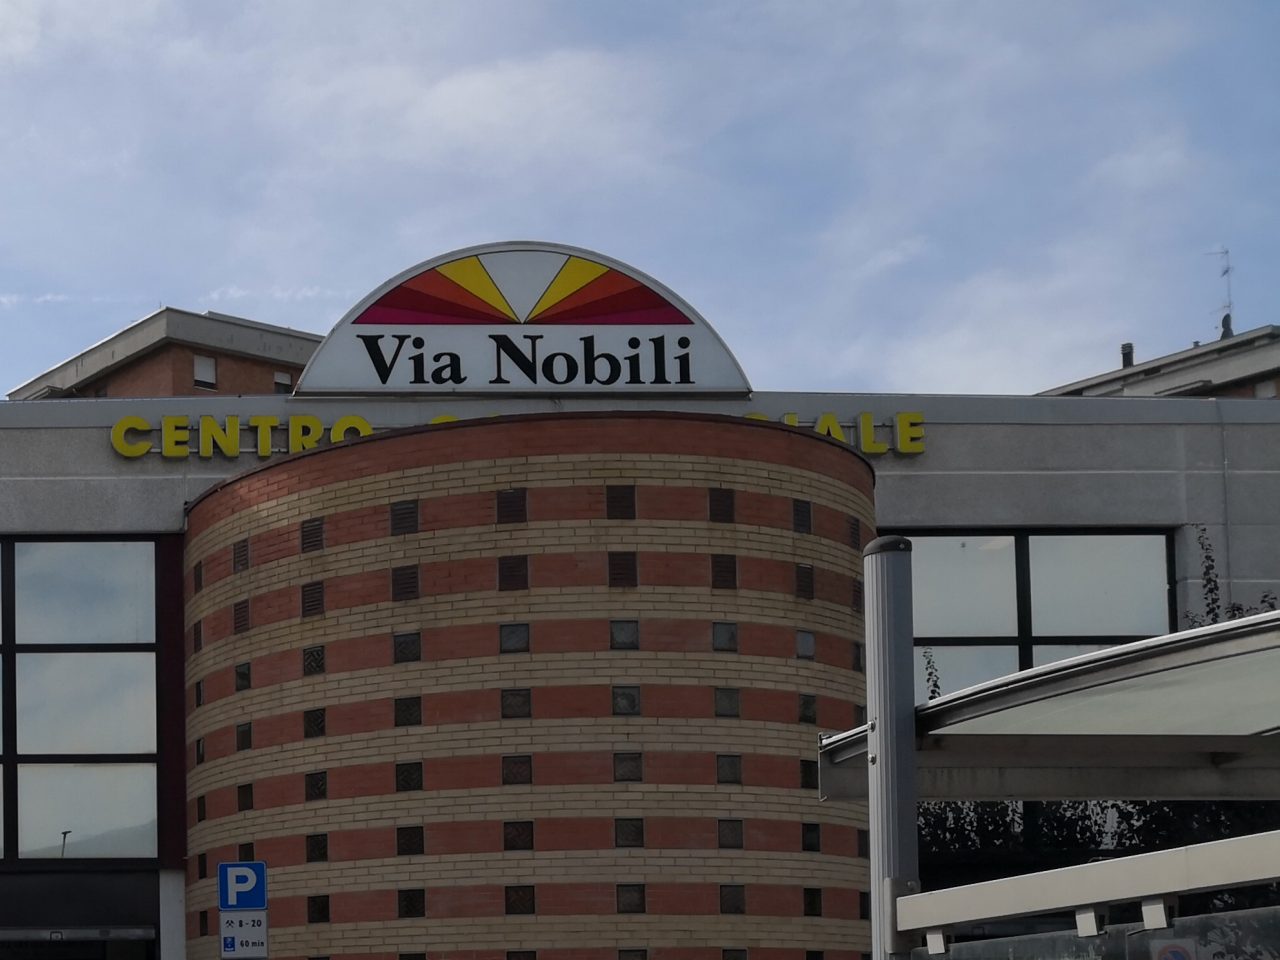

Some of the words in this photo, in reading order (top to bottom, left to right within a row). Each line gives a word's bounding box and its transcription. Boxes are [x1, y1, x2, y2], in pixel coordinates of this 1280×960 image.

[357, 334, 468, 385] Via
[488, 334, 696, 386] Nobili
[110, 414, 374, 457] CENTRO
[227, 866, 257, 906] P
[239, 940, 250, 948] 60
[251, 940, 265, 948] min
